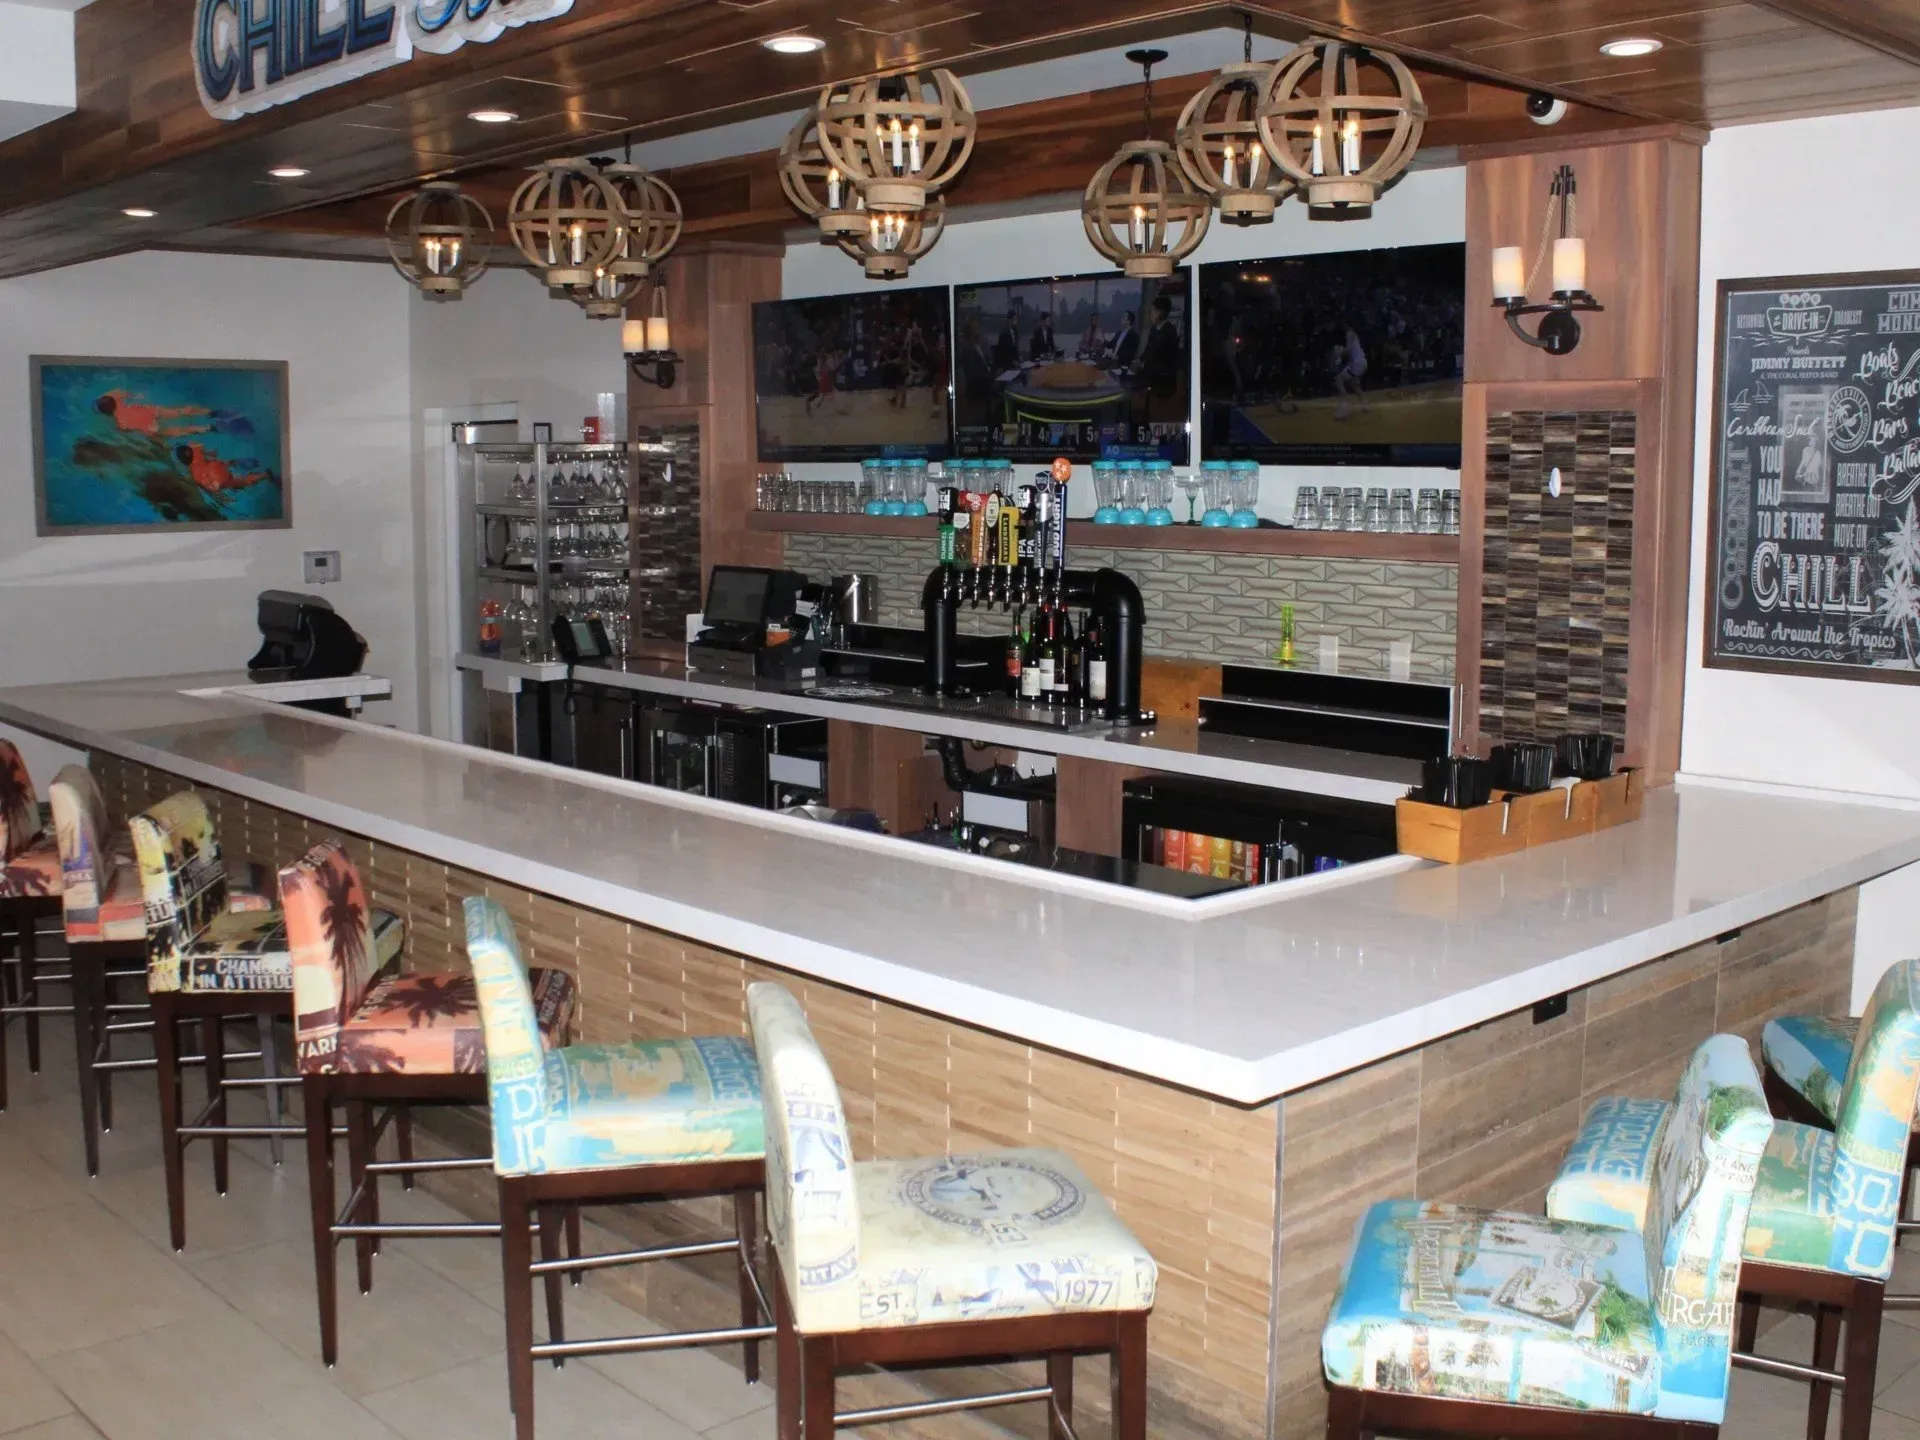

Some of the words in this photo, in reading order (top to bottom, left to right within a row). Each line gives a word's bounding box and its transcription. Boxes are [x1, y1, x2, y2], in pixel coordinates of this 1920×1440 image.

[200, 0, 396, 101] CHILL
[1751, 357, 1790, 372] JIMMY
[1792, 356, 1847, 369] BUFFETT
[1760, 446, 1781, 473] YOU
[1836, 463, 1867, 487] BREATHE
[1758, 478, 1781, 506] HAD
[1052, 497, 1061, 531] LIGHT
[1835, 493, 1866, 517] BREATHE
[1757, 511, 1771, 538] TO
[1774, 512, 1787, 539] BE
[1790, 512, 1825, 540] THERE
[1834, 523, 1855, 548] MOVE
[1856, 524, 1867, 548] ON
[1018, 539, 1027, 558] IPA
[1052, 532, 1061, 557] BUD
[1752, 541, 1874, 613] CHILL
[1772, 622, 1821, 643] Around
[1824, 625, 1845, 644] the
[1848, 627, 1897, 651] Tropics
[199, 974, 217, 988] IN
[1065, 1279, 1113, 1305] 1977
[1680, 1334, 1715, 1347] BACK
